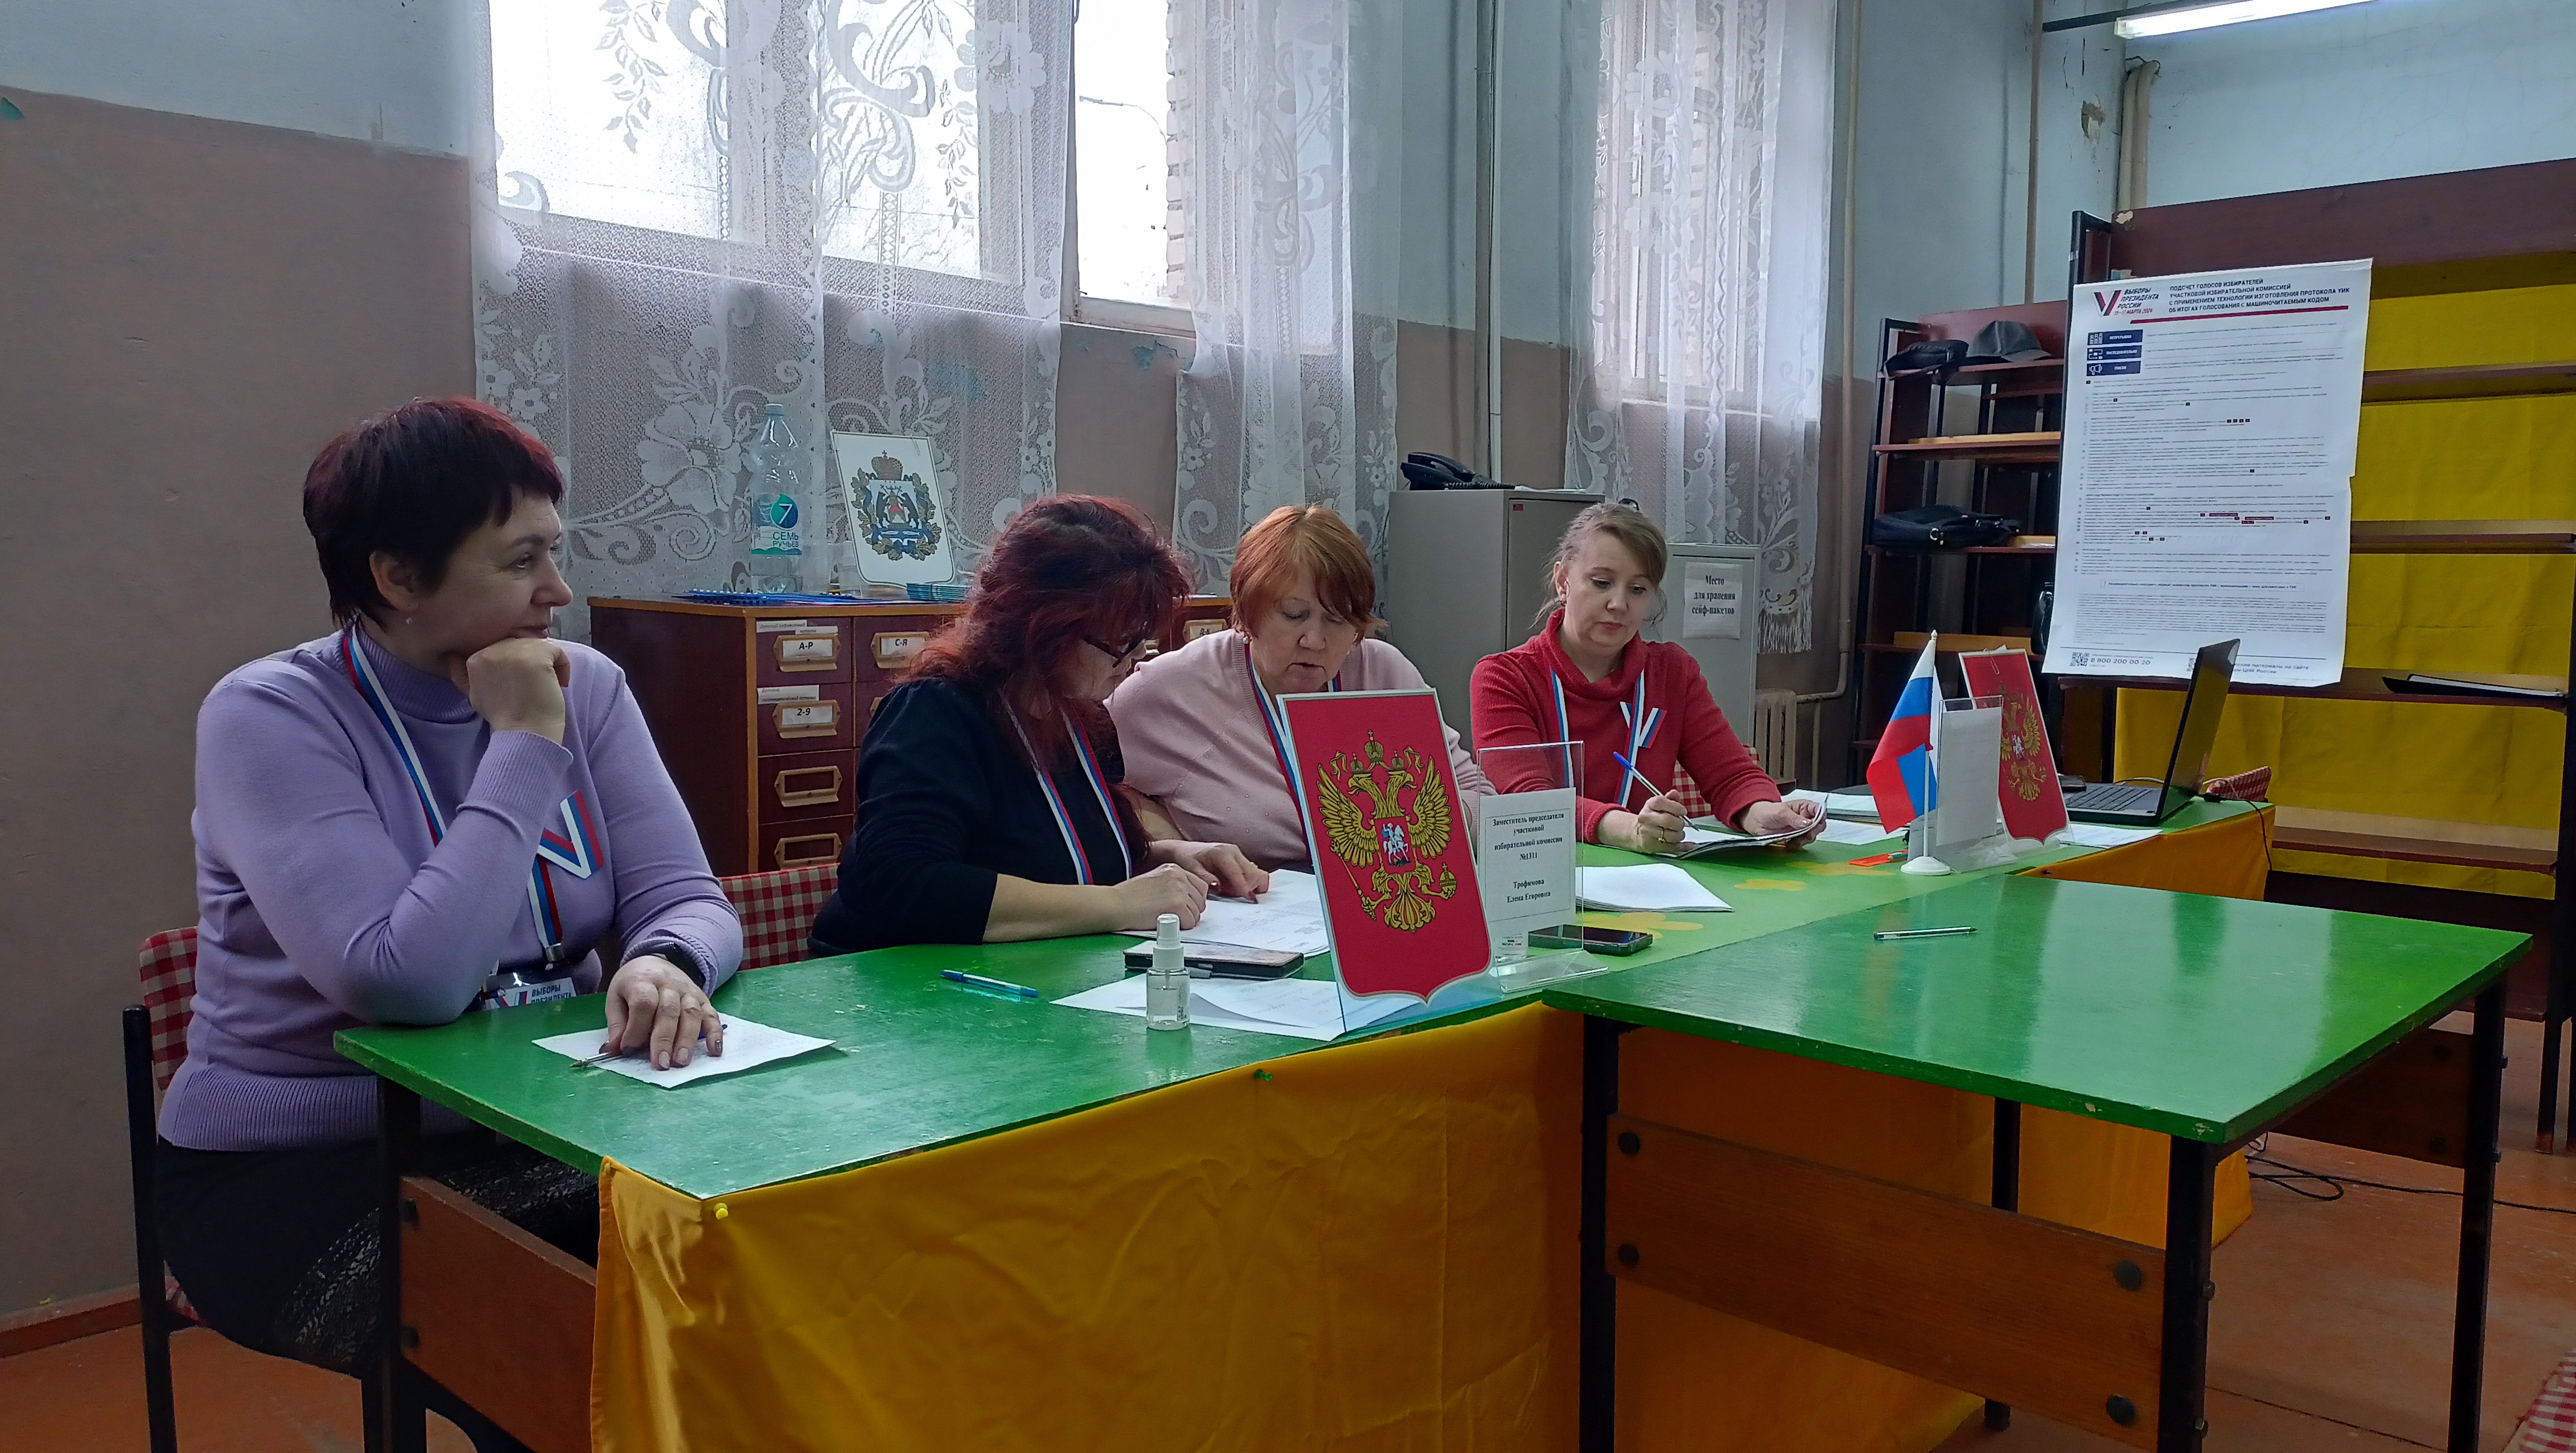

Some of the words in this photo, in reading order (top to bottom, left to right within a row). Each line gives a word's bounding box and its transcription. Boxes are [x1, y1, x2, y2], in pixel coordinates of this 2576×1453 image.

[2223, 279, 2263, 287] ИЗБИРАТЕЛЕЙ
[2170, 290, 2206, 298] УЧАСТКОВОЙ
[2207, 286, 2255, 296] ИЗБИРАТЕЛЬНОЙ
[2217, 294, 2253, 303] ТЕХНОЛОГИИ
[2254, 291, 2299, 299] ИЗГОТОВЛЕНИЯ
[2120, 294, 2159, 302] ПРЕЗИДЕНТА
[2246, 298, 2306, 307] МАШИНОЧИТАЕМЫМ
[779, 504, 793, 524] 7
[773, 532, 799, 540] СЕМЬ
[1705, 575, 1725, 586] Место
[1706, 592, 1736, 602] хранения
[1692, 604, 1735, 617] сейф-пакетов
[799, 642, 813, 650] А-Р
[797, 708, 811, 716] 2-9
[1493, 817, 1527, 826] Заместитель
[1528, 813, 1564, 823] председателя
[1513, 825, 1544, 836] участковой
[1494, 839, 1535, 850] избирательной
[1536, 837, 1563, 845] комиссии
[1520, 852, 1538, 860] №1311
[1513, 879, 1544, 890] Трофимова
[1525, 891, 1550, 900] Егоровна
[531, 984, 561, 997] ВЫБОРЫ
